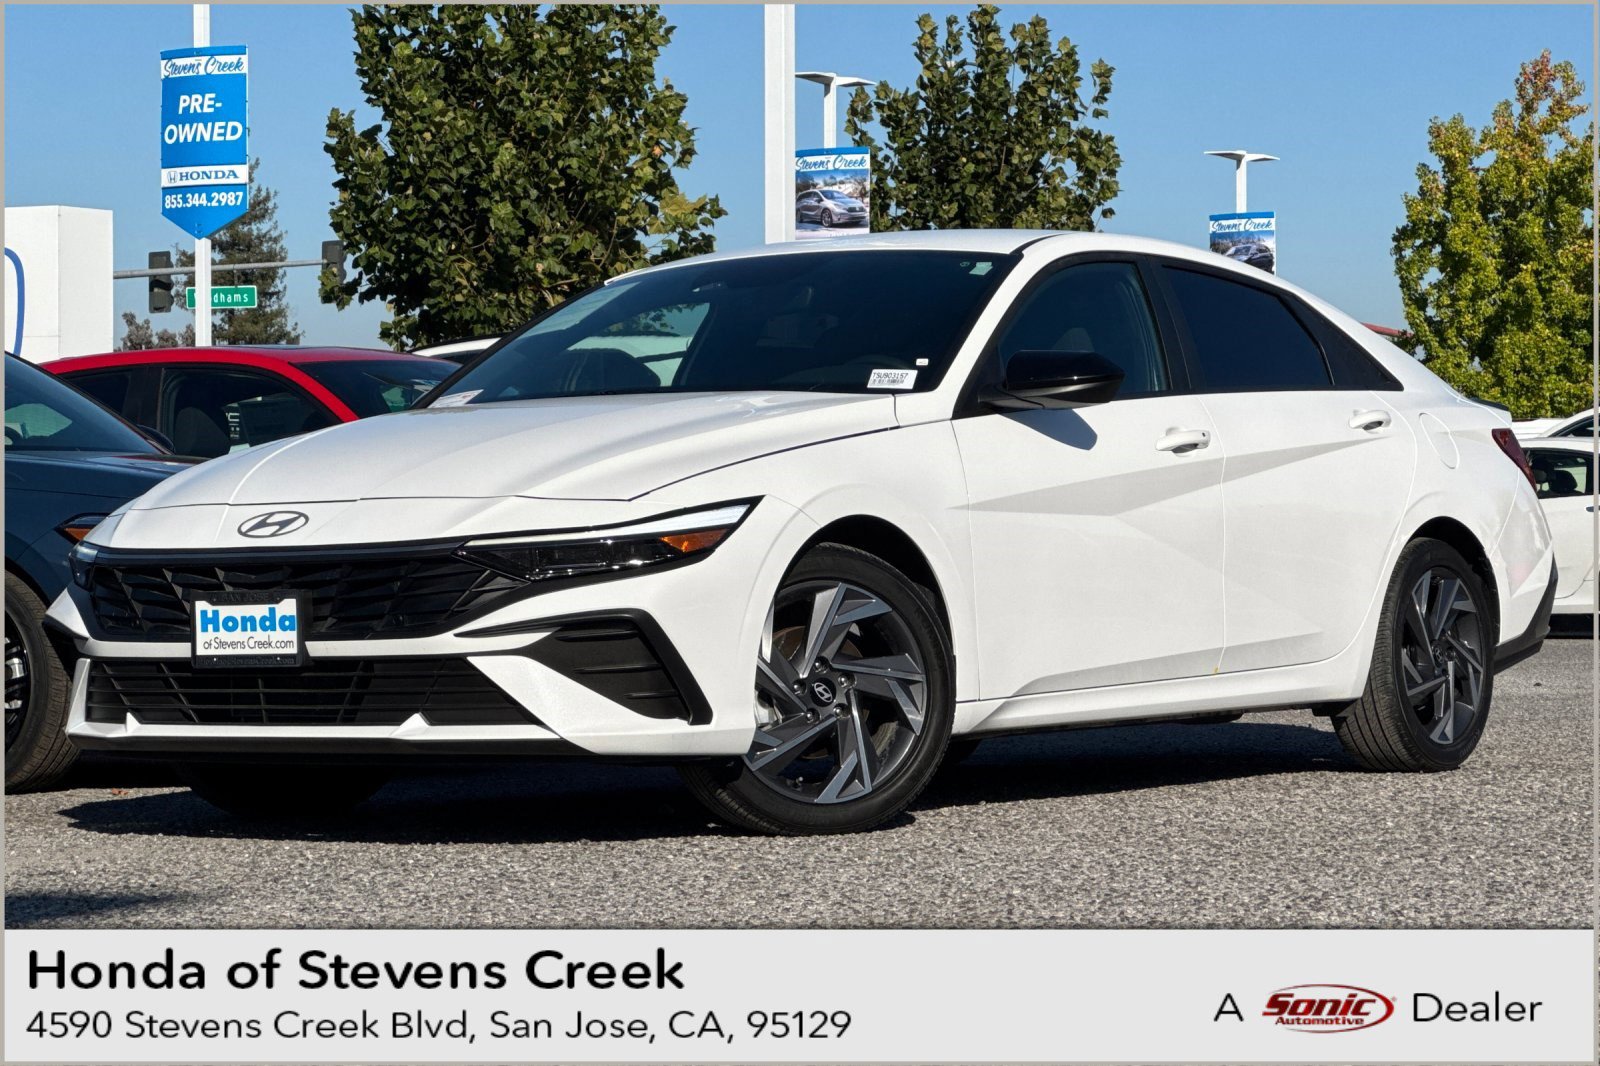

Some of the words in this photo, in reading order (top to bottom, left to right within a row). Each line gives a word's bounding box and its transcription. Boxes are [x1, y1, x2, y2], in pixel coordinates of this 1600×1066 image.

[204, 56, 244, 75] Creek
[178, 93, 222, 114] PRE-
[164, 121, 243, 145] OWNED
[832, 154, 866, 170] Creek
[179, 169, 239, 182] HONDA
[164, 191, 243, 209] 855.344.2987
[1243, 218, 1272, 231] Creek
[200, 606, 297, 633] Honda
